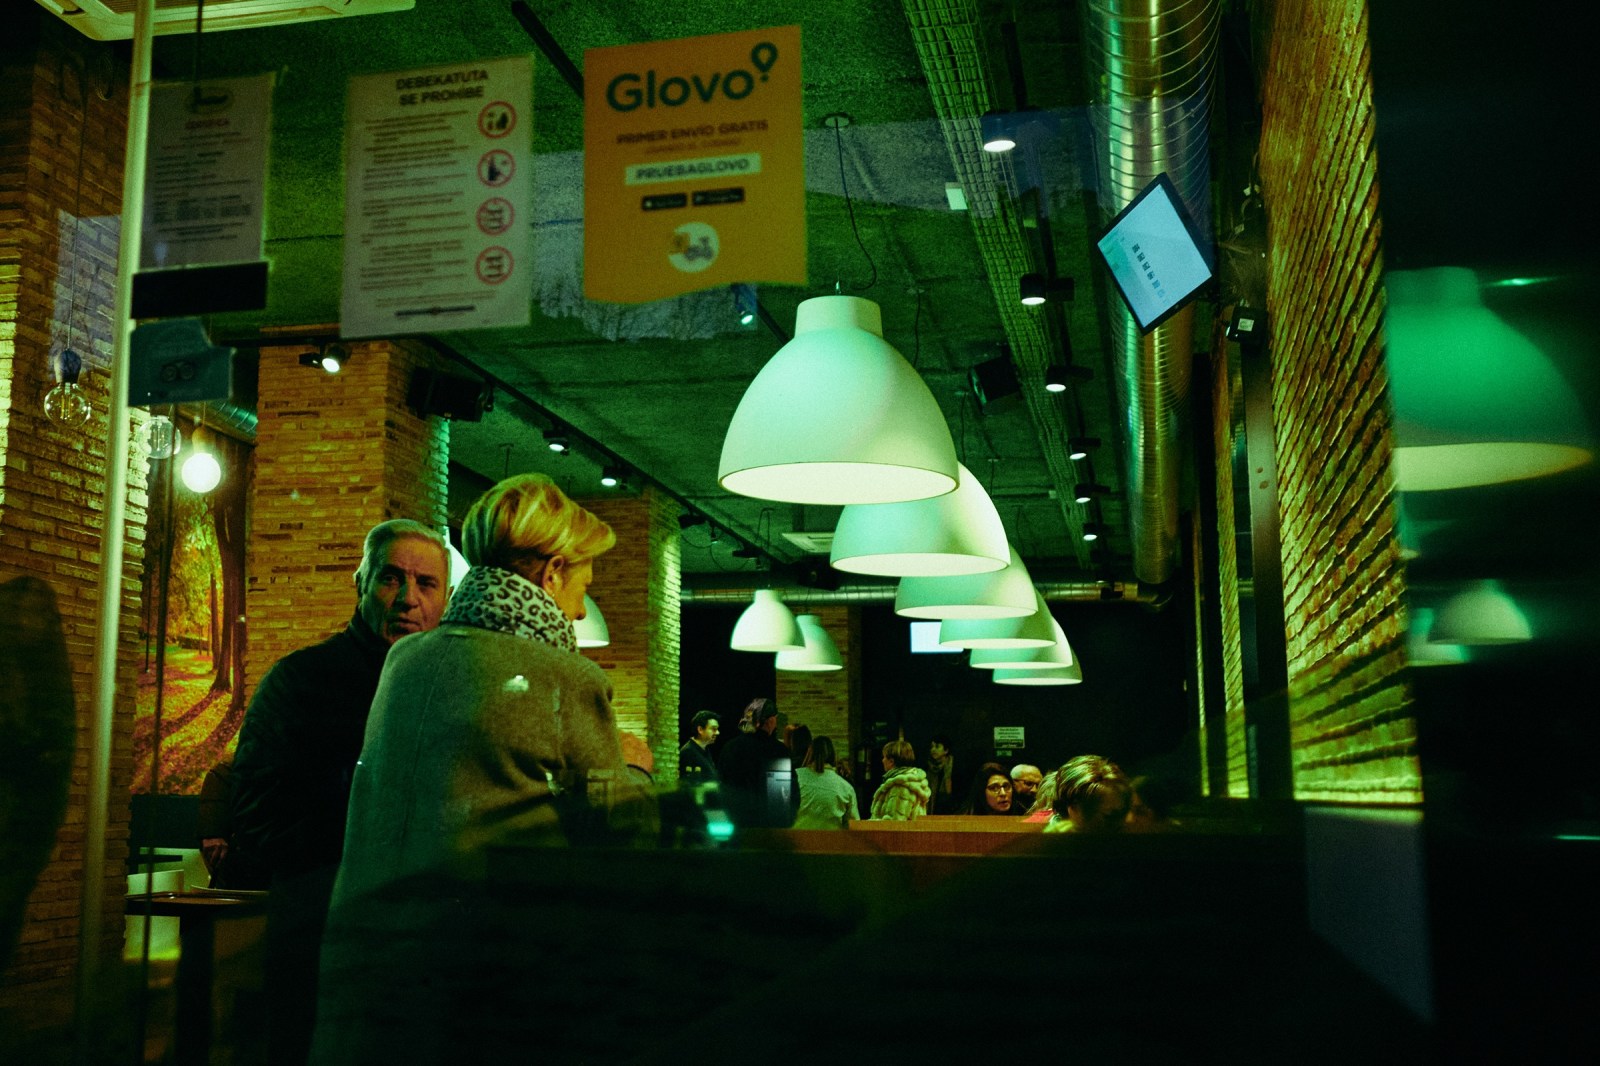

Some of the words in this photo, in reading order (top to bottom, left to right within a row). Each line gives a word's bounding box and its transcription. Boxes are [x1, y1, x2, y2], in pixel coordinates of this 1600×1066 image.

[396, 70, 488, 91] DEBEKATUTA
[606, 69, 755, 112] Glovo
[399, 93, 418, 106] SE
[616, 129, 668, 144] PRIMER
[718, 119, 768, 135] GRATIS
[636, 158, 749, 179] PRUEBAGLOVO
